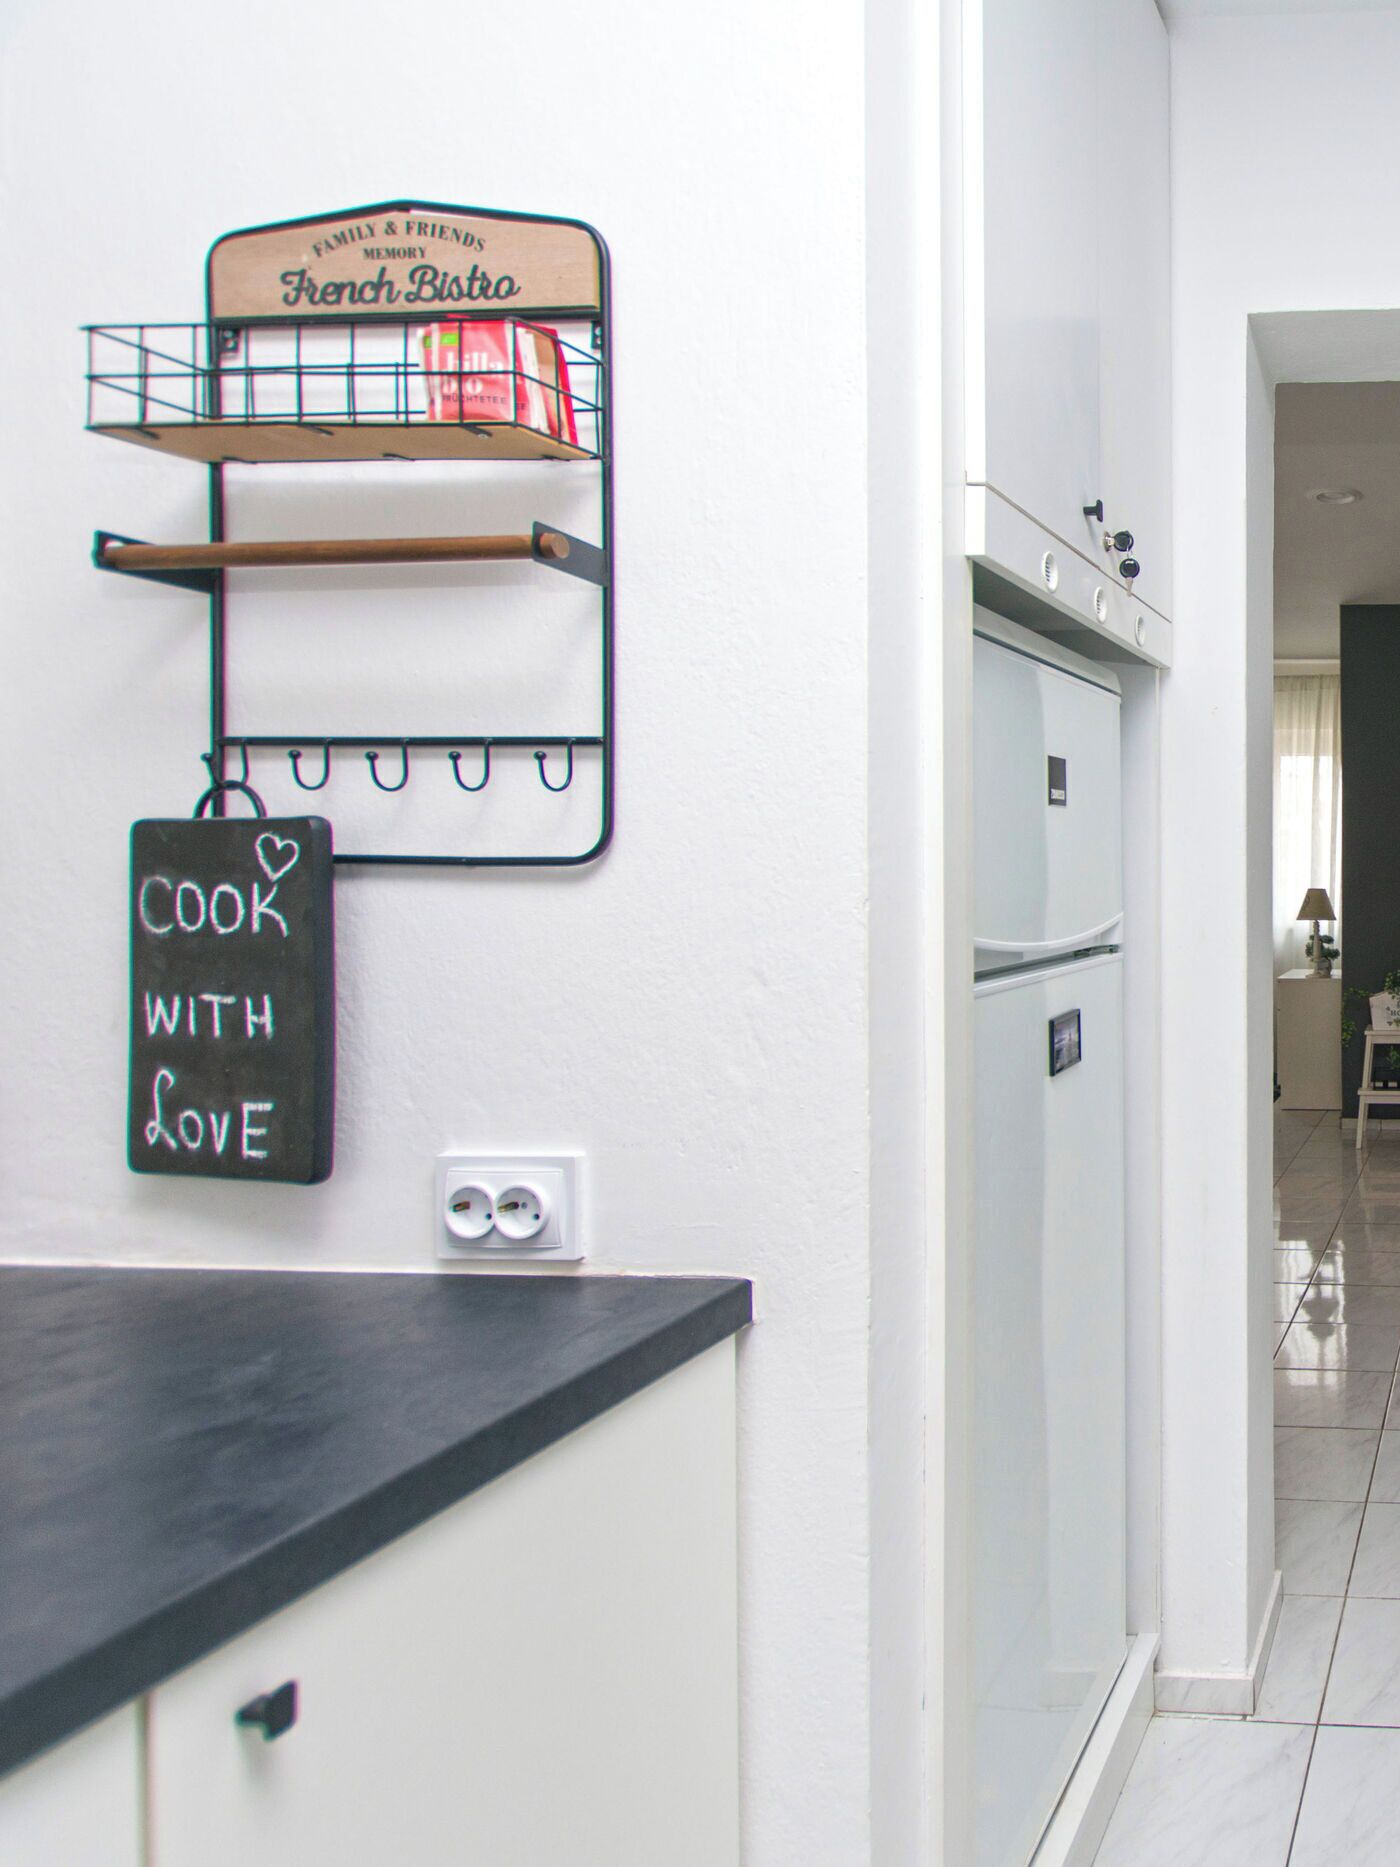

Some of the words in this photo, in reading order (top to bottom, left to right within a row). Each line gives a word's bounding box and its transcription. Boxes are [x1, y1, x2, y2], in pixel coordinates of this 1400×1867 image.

[312, 222, 377, 258] FAMILY
[384, 220, 399, 236] &
[405, 220, 487, 253] FRIENDS
[363, 246, 427, 261] MEMORY
[280, 266, 401, 307] French
[403, 264, 521, 304] Bistro
[139, 874, 290, 939] COOK
[144, 992, 274, 1039] WITH
